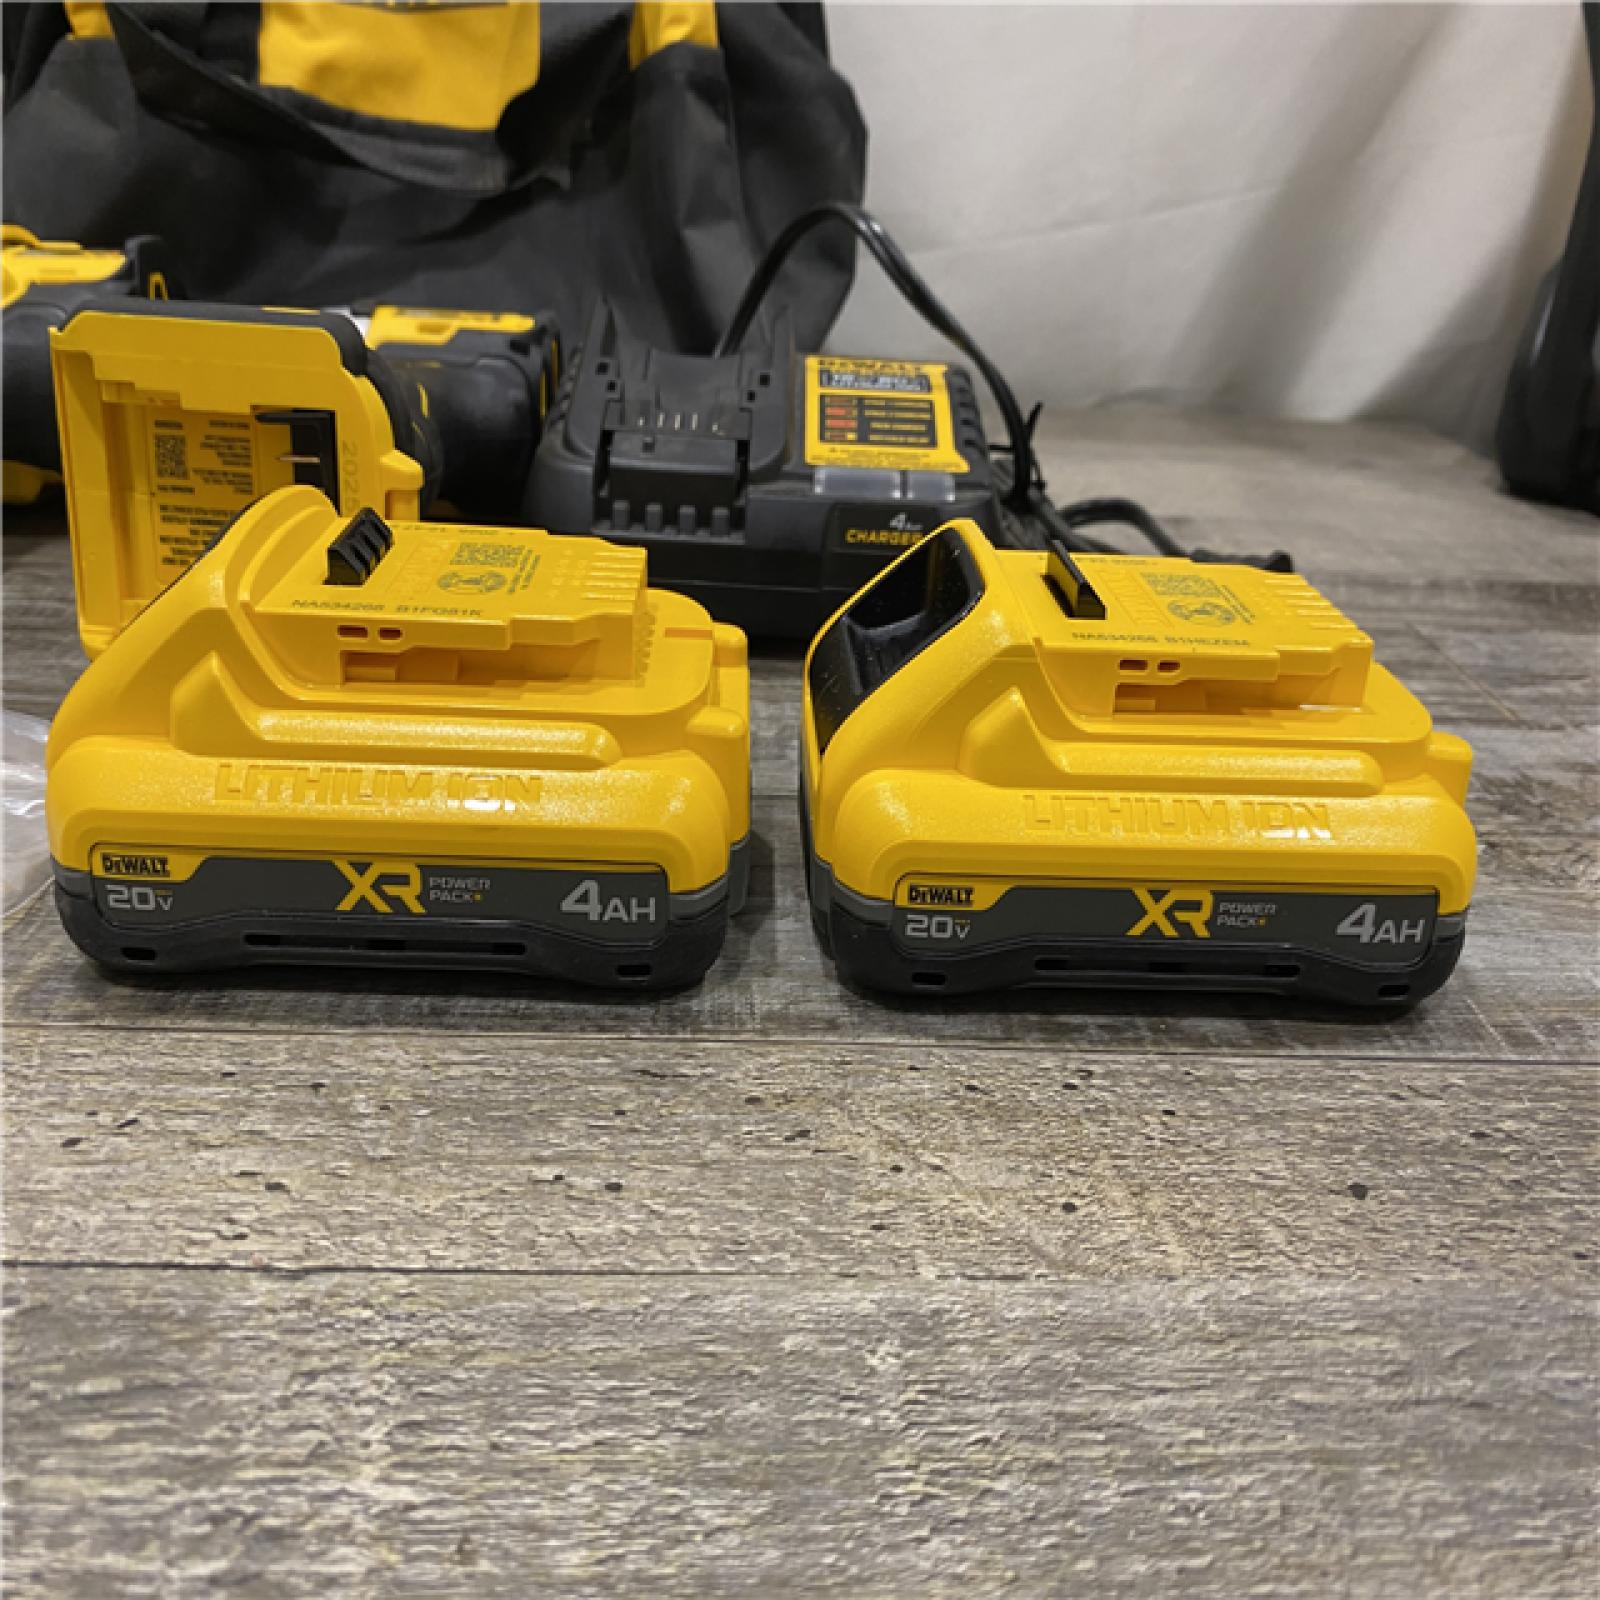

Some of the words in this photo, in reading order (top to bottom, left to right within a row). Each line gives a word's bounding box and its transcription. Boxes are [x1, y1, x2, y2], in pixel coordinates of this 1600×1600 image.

[213, 762, 434, 808] LITHIUM
[446, 771, 542, 812] ION
[1021, 794, 1230, 838] LITHIUM
[1240, 800, 1333, 841] ION
[331, 861, 426, 914] XR
[429, 877, 491, 891] POWER
[1126, 888, 1214, 938] XR
[1218, 902, 1277, 916] POWER
